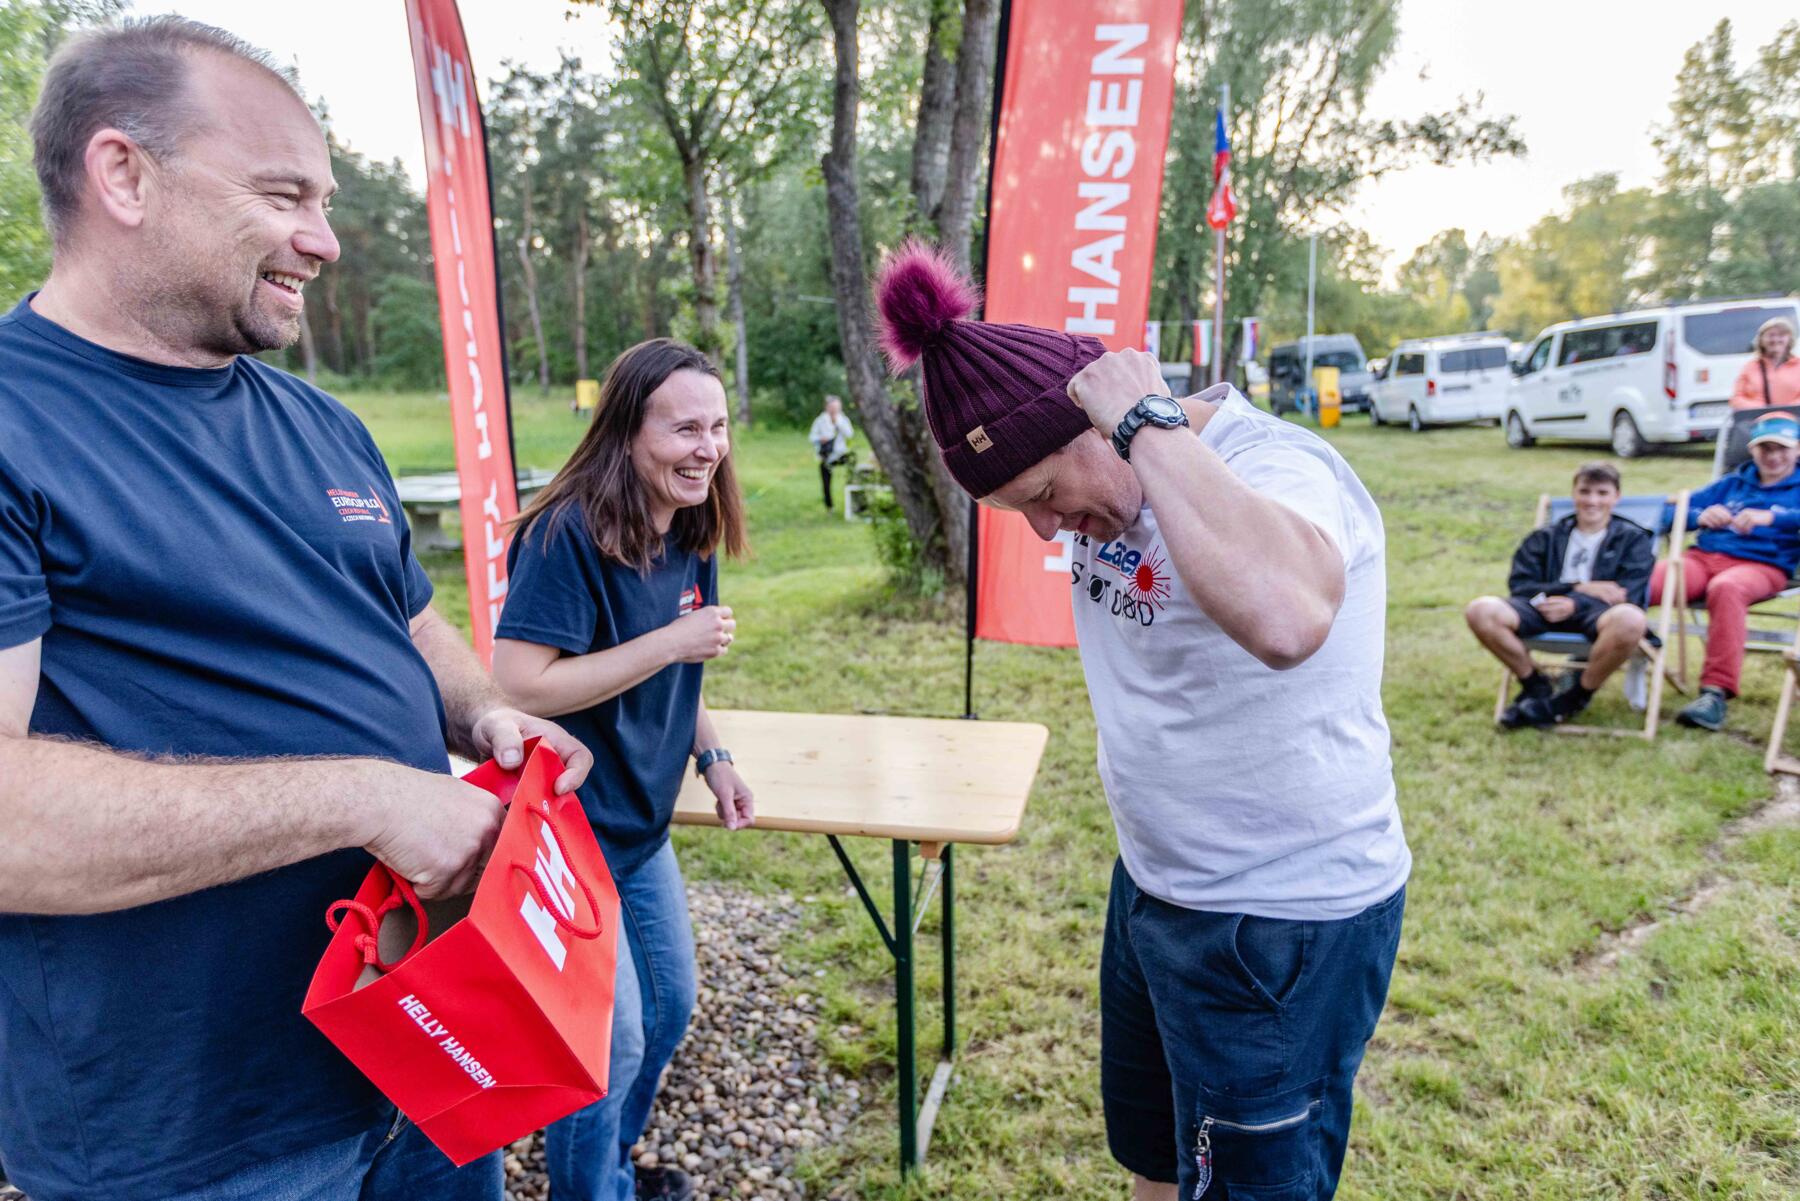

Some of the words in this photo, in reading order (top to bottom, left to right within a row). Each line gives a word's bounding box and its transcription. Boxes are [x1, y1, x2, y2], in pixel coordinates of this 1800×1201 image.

[1064, 23, 1149, 335] HANSEN
[398, 994, 448, 1037] HELLY
[439, 1036, 497, 1089] HANSEN
